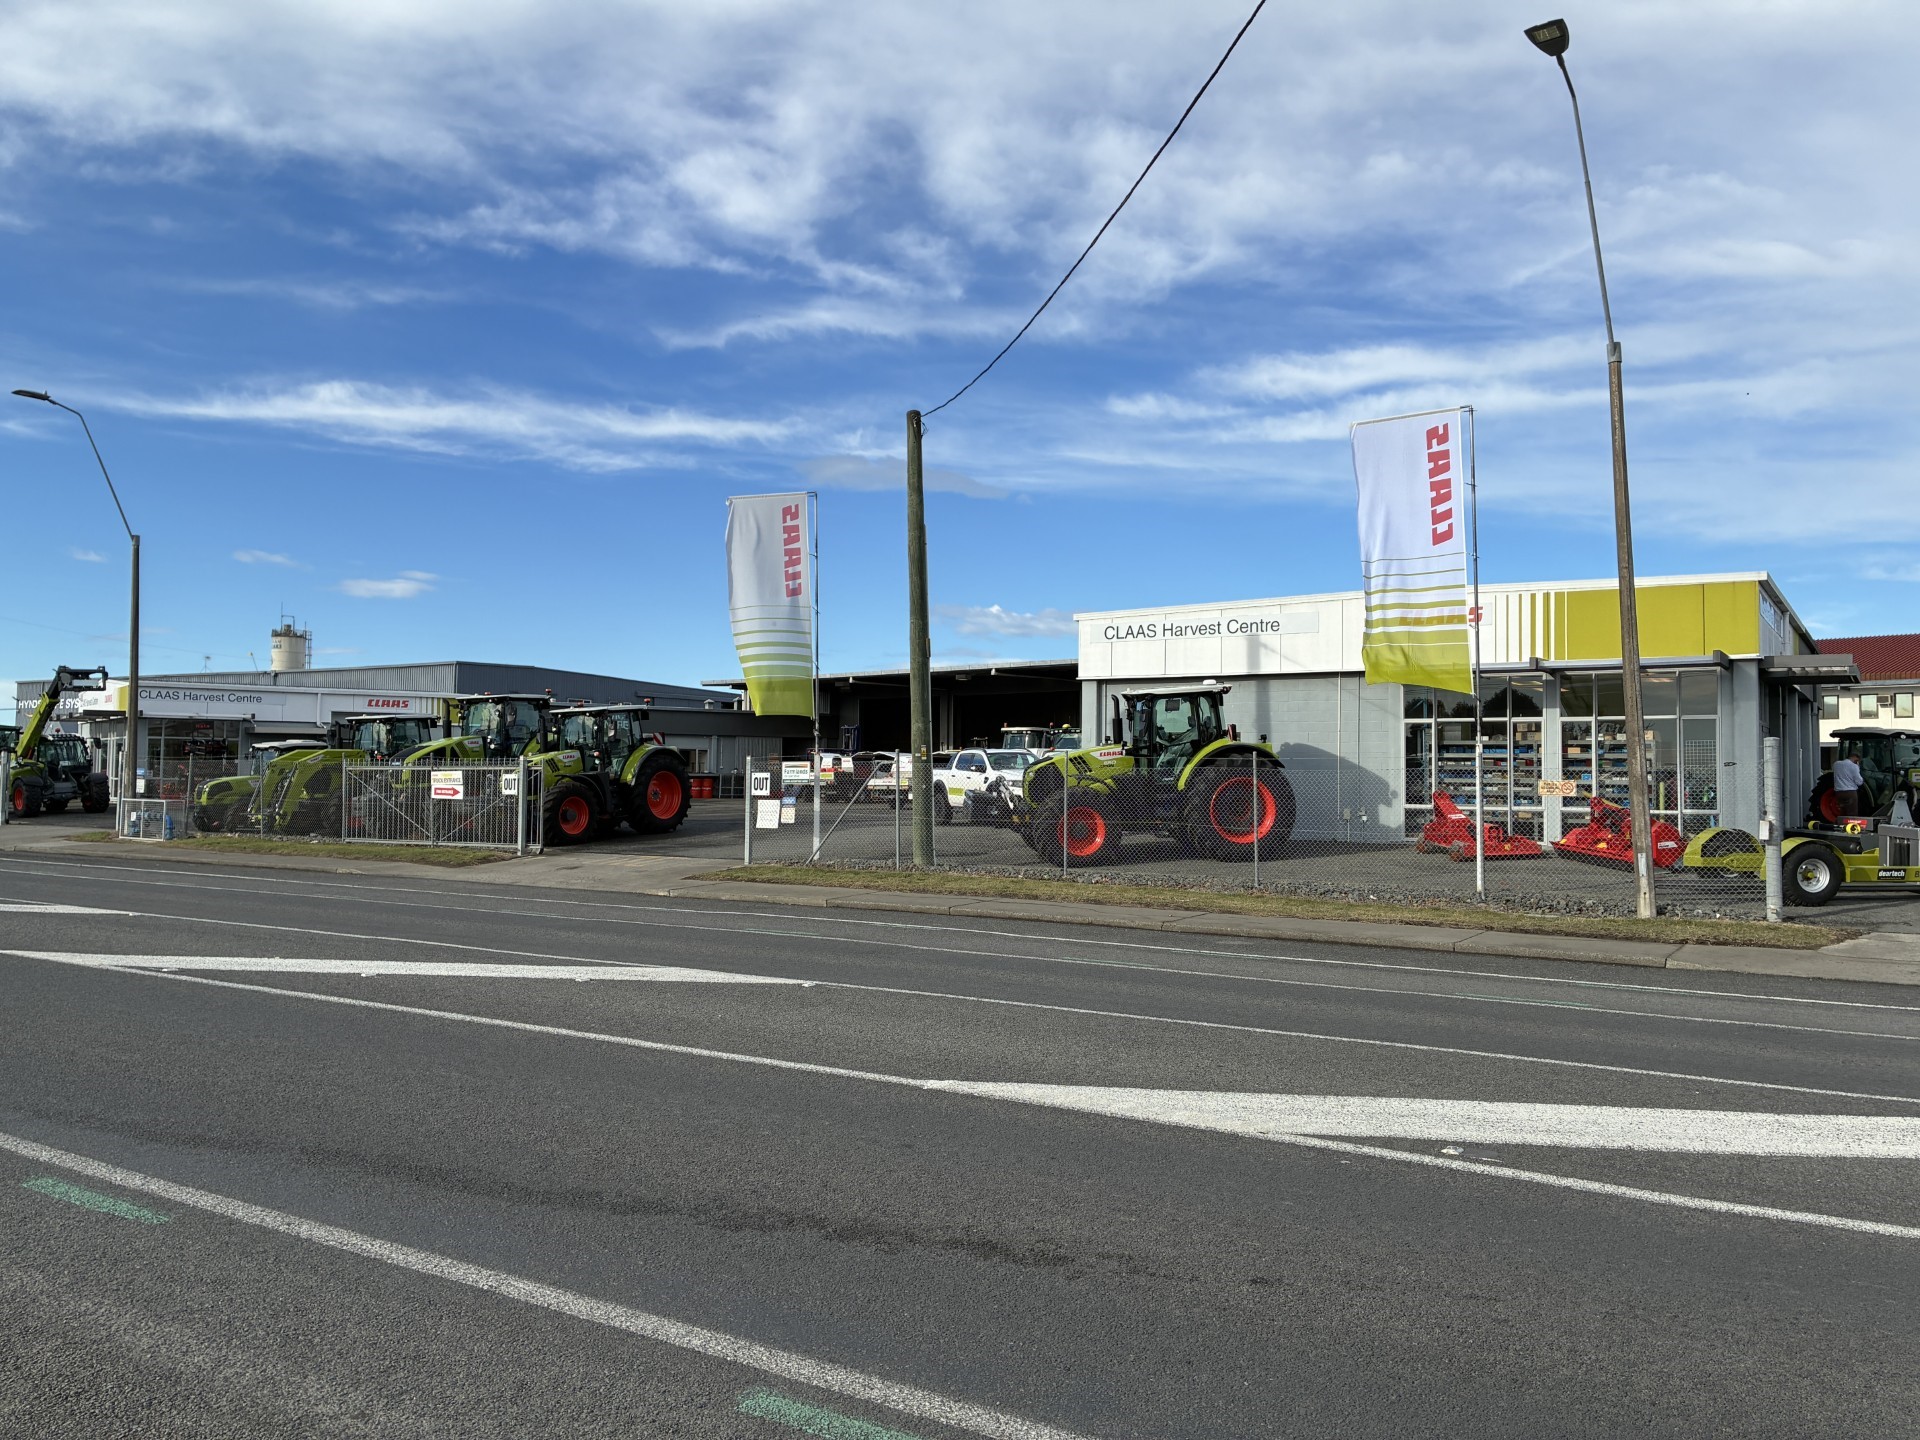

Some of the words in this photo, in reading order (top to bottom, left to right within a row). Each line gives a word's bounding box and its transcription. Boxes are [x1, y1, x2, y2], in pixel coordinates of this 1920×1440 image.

[1104, 623, 1157, 640] CLAAS
[1162, 621, 1222, 637] Harvest
[1226, 618, 1280, 634] Centre
[139, 689, 180, 701] CLAAS
[183, 691, 225, 702] Harvest
[227, 693, 262, 703] Centre
[367, 699, 409, 708] CLAAS
[1099, 750, 1124, 758] CLAAS
[504, 778, 517, 790] OUT
[753, 777, 769, 791] OUT
[1879, 869, 1905, 877] deartech
